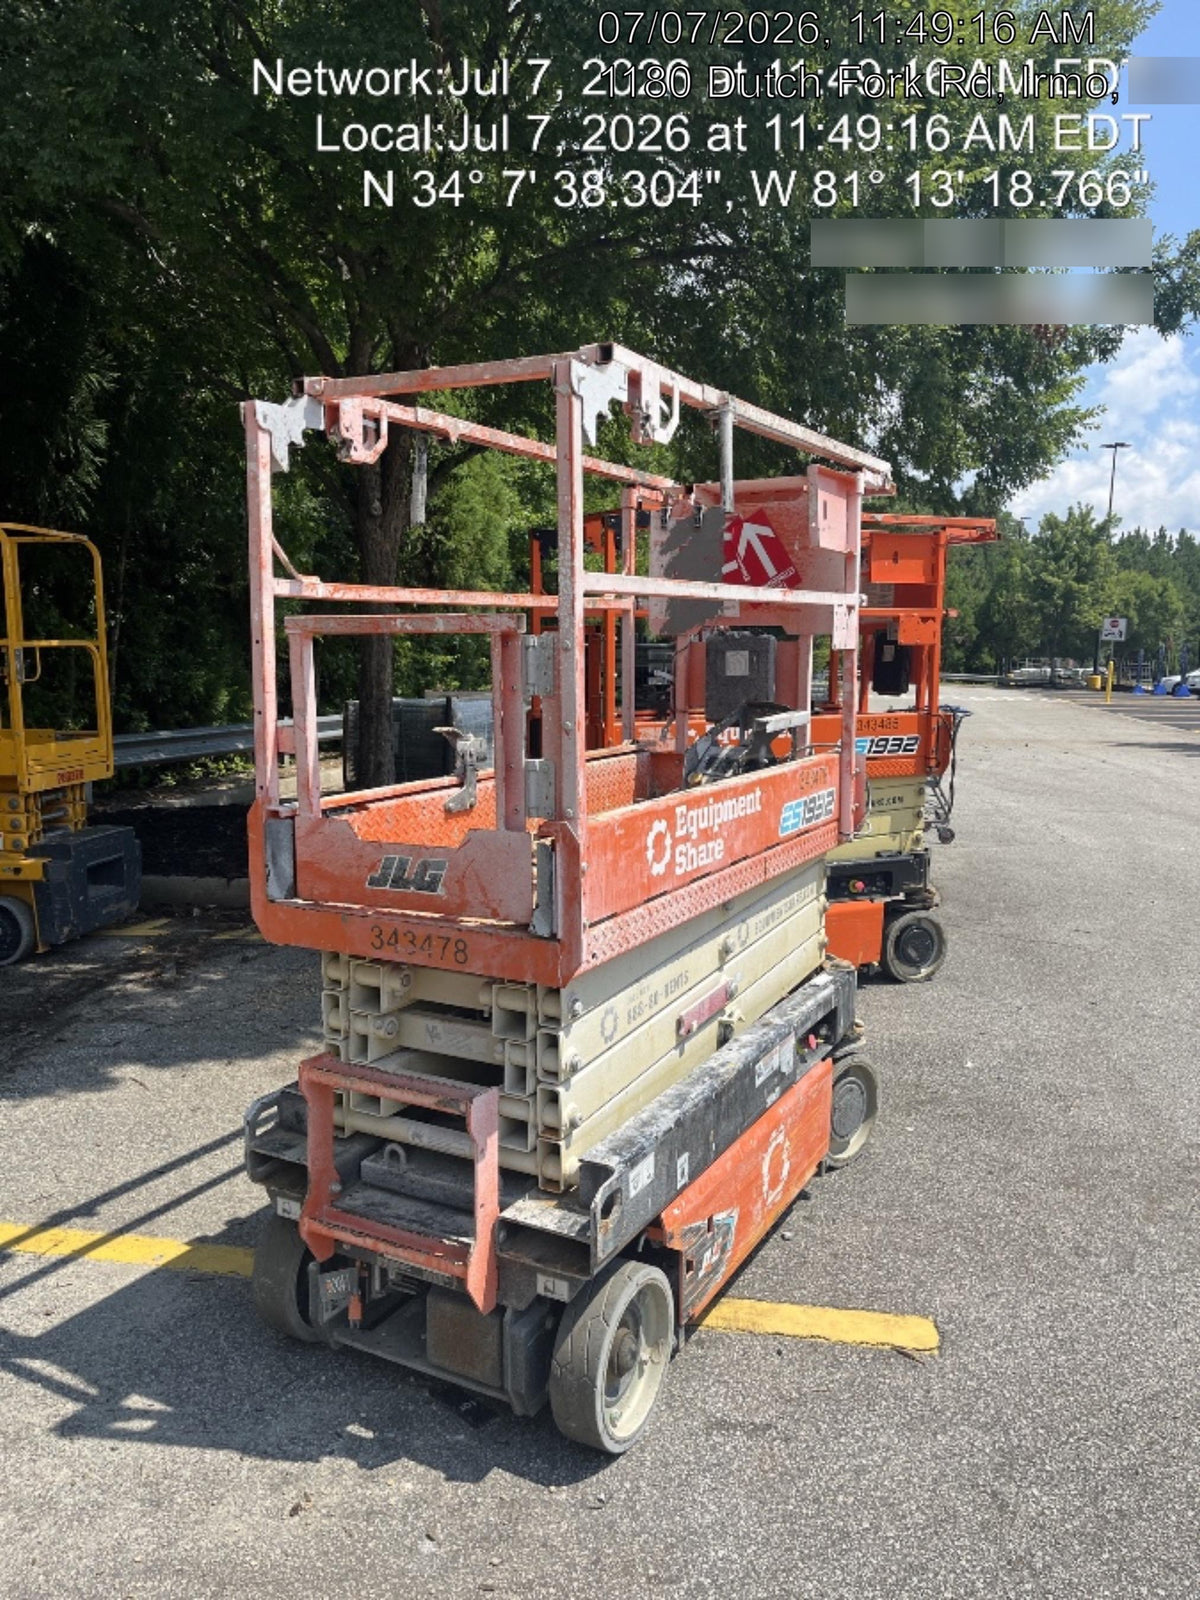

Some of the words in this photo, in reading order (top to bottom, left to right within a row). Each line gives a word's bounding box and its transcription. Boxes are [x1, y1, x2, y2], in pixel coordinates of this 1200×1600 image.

[674, 787, 762, 840] Equipment
[779, 787, 836, 835] ES1932
[366, 854, 449, 895] JLG
[674, 839, 724, 876] Share
[370, 925, 469, 965] 343478
